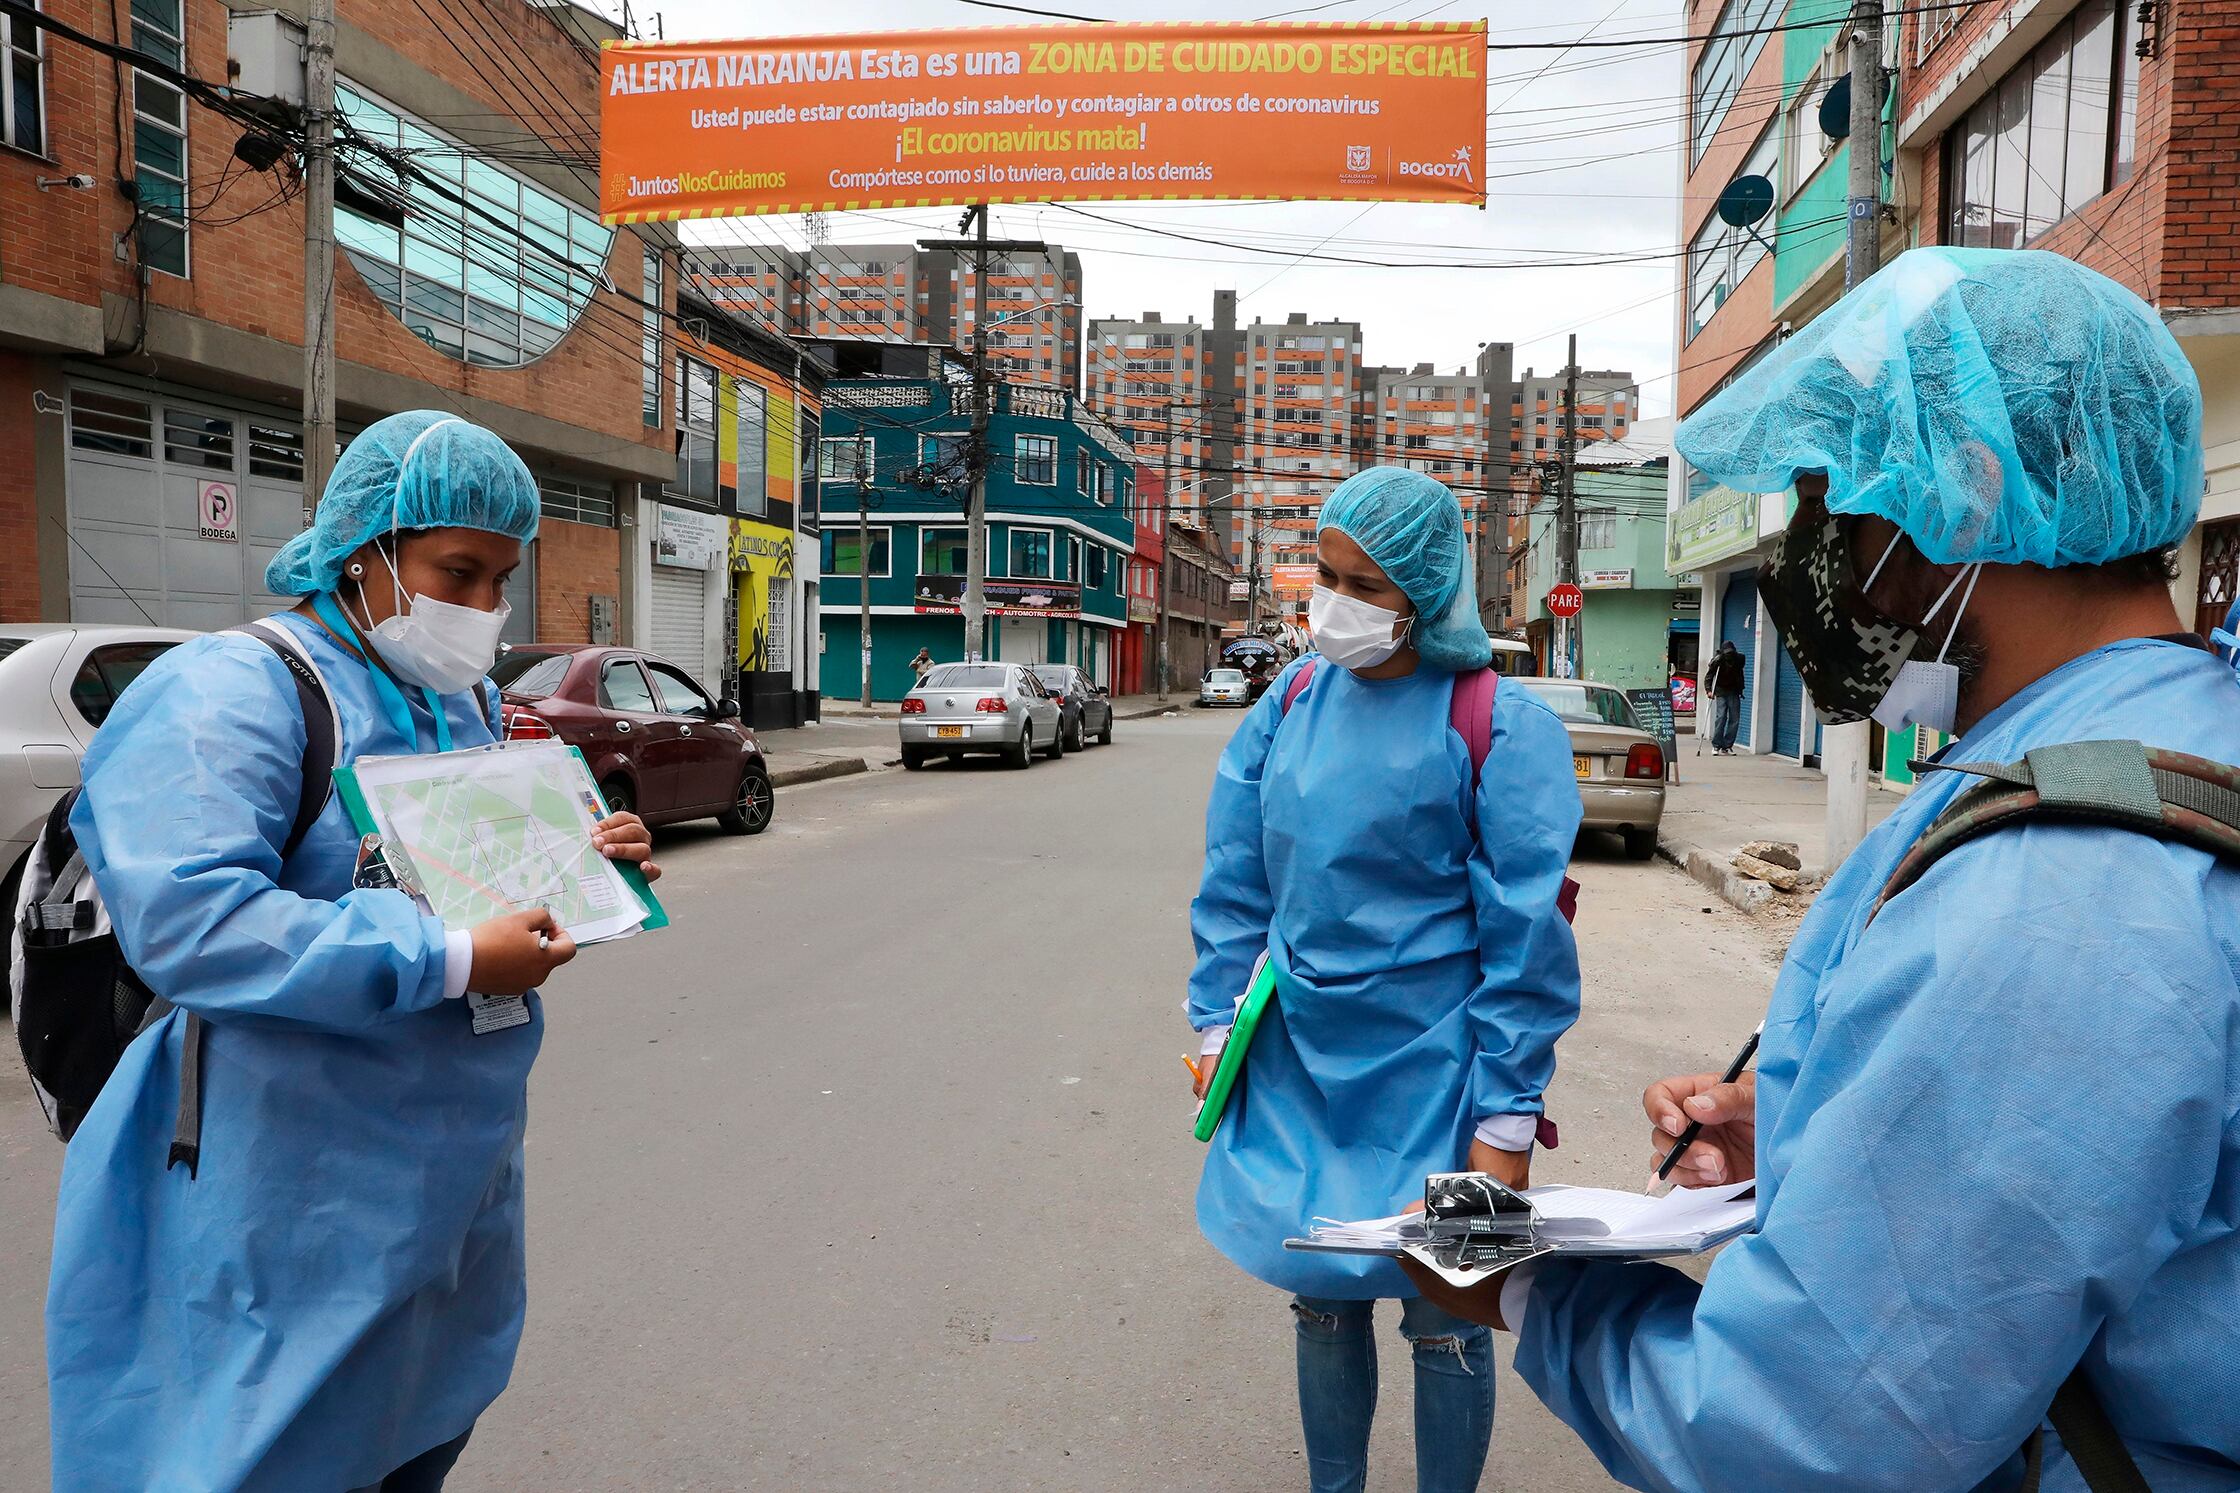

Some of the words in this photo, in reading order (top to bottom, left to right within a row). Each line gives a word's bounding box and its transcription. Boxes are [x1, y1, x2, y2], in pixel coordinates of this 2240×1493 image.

[610, 58, 712, 96] ALERTA
[717, 50, 854, 88] NARANJA
[860, 49, 919, 80] Esta
[926, 50, 958, 77] es
[964, 49, 1021, 76] una
[1027, 42, 1118, 74] ZONA
[1124, 41, 1166, 73] DE
[1171, 41, 1323, 74] CUIDADO
[1330, 43, 1478, 78] ESPECIAL
[690, 106, 739, 129] Usted
[743, 103, 796, 131] puede
[800, 103, 844, 122] estar
[847, 97, 949, 123] contagiado
[953, 96, 979, 116] sin
[983, 94, 1054, 116] saberlo
[1055, 98, 1068, 118] y
[1071, 92, 1163, 117] contagiar
[1165, 98, 1177, 112] a
[1181, 94, 1233, 113] otros
[1236, 92, 1260, 112] de
[1264, 94, 1380, 115] coronavirus
[895, 127, 924, 163] ¡El
[927, 123, 1072, 155] coronavirus
[1076, 121, 1147, 151] mata!
[609, 168, 786, 202] #JuntosNosCuidamos
[828, 167, 923, 192] Compórtese
[925, 169, 972, 185] como
[973, 164, 986, 184] si
[988, 164, 1005, 183] lo
[1007, 163, 1067, 184] tuviera,
[1070, 162, 1116, 182] cuide
[1117, 167, 1128, 181] a
[1131, 162, 1156, 181] los
[1158, 161, 1213, 182] demás
[201, 527, 236, 540] BODEGA
[1003, 610, 1047, 618] AUTOMOTRIZ
[1550, 593, 1580, 608] PARE
[284, 653, 317, 685] TOTTO
